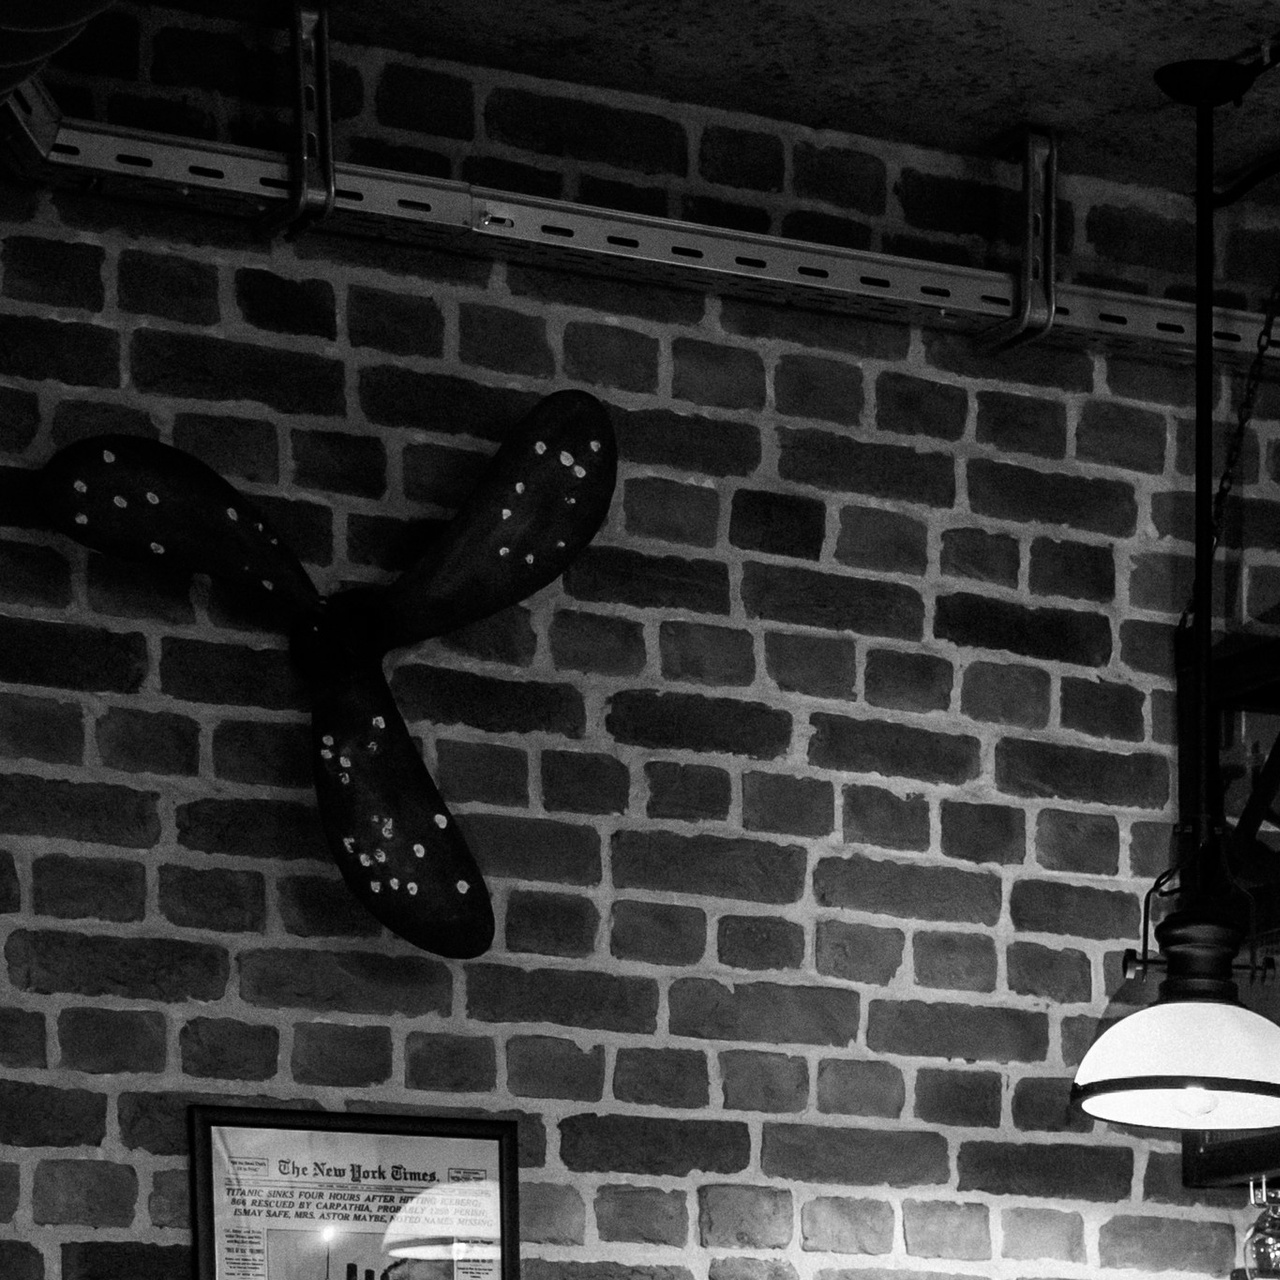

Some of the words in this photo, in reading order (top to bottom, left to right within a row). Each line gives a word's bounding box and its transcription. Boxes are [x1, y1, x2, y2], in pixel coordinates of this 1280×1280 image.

[278, 1159, 308, 1178] The
[313, 1161, 346, 1178] New
[350, 1163, 387, 1182] York
[226, 1187, 264, 1198] TITANIC
[267, 1189, 294, 1198] SINKS
[298, 1191, 324, 1200] FOUR
[328, 1192, 360, 1201] HOURS
[364, 1194, 395, 1203] AFTER
[251, 1199, 295, 1209] RESCUED
[298, 1201, 312, 1209] BY
[233, 1208, 263, 1217] ISMAY
[319, 1212, 351, 1221] ASTOR
